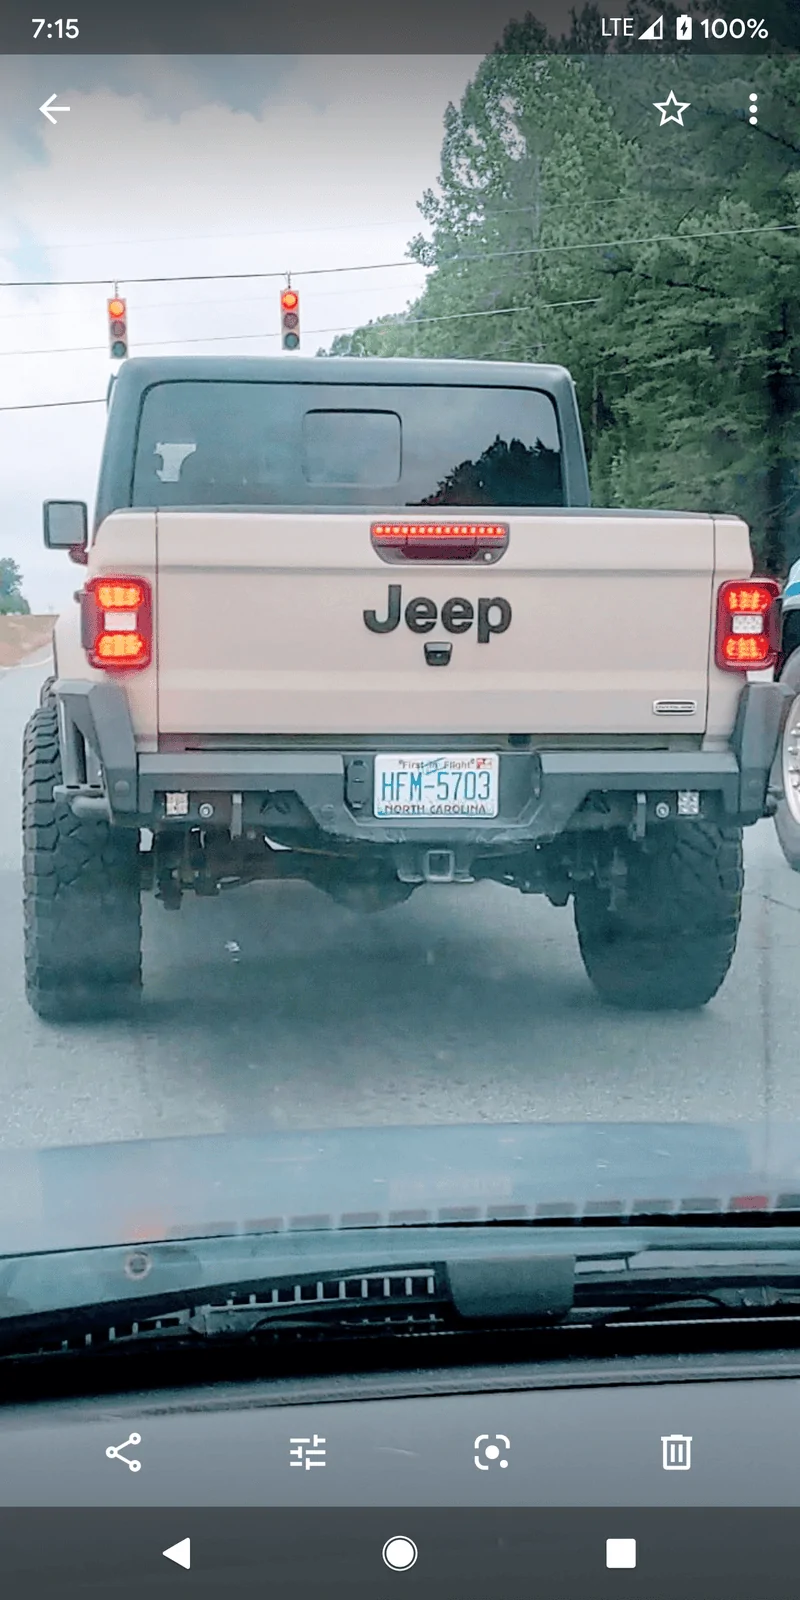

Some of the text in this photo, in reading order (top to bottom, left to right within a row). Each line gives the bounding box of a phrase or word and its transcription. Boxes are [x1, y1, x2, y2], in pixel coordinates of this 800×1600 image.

[363, 584, 512, 644] Jeep
[382, 771, 491, 801] HFM-5703
[384, 804, 486, 815] NORTH CAROLINA
